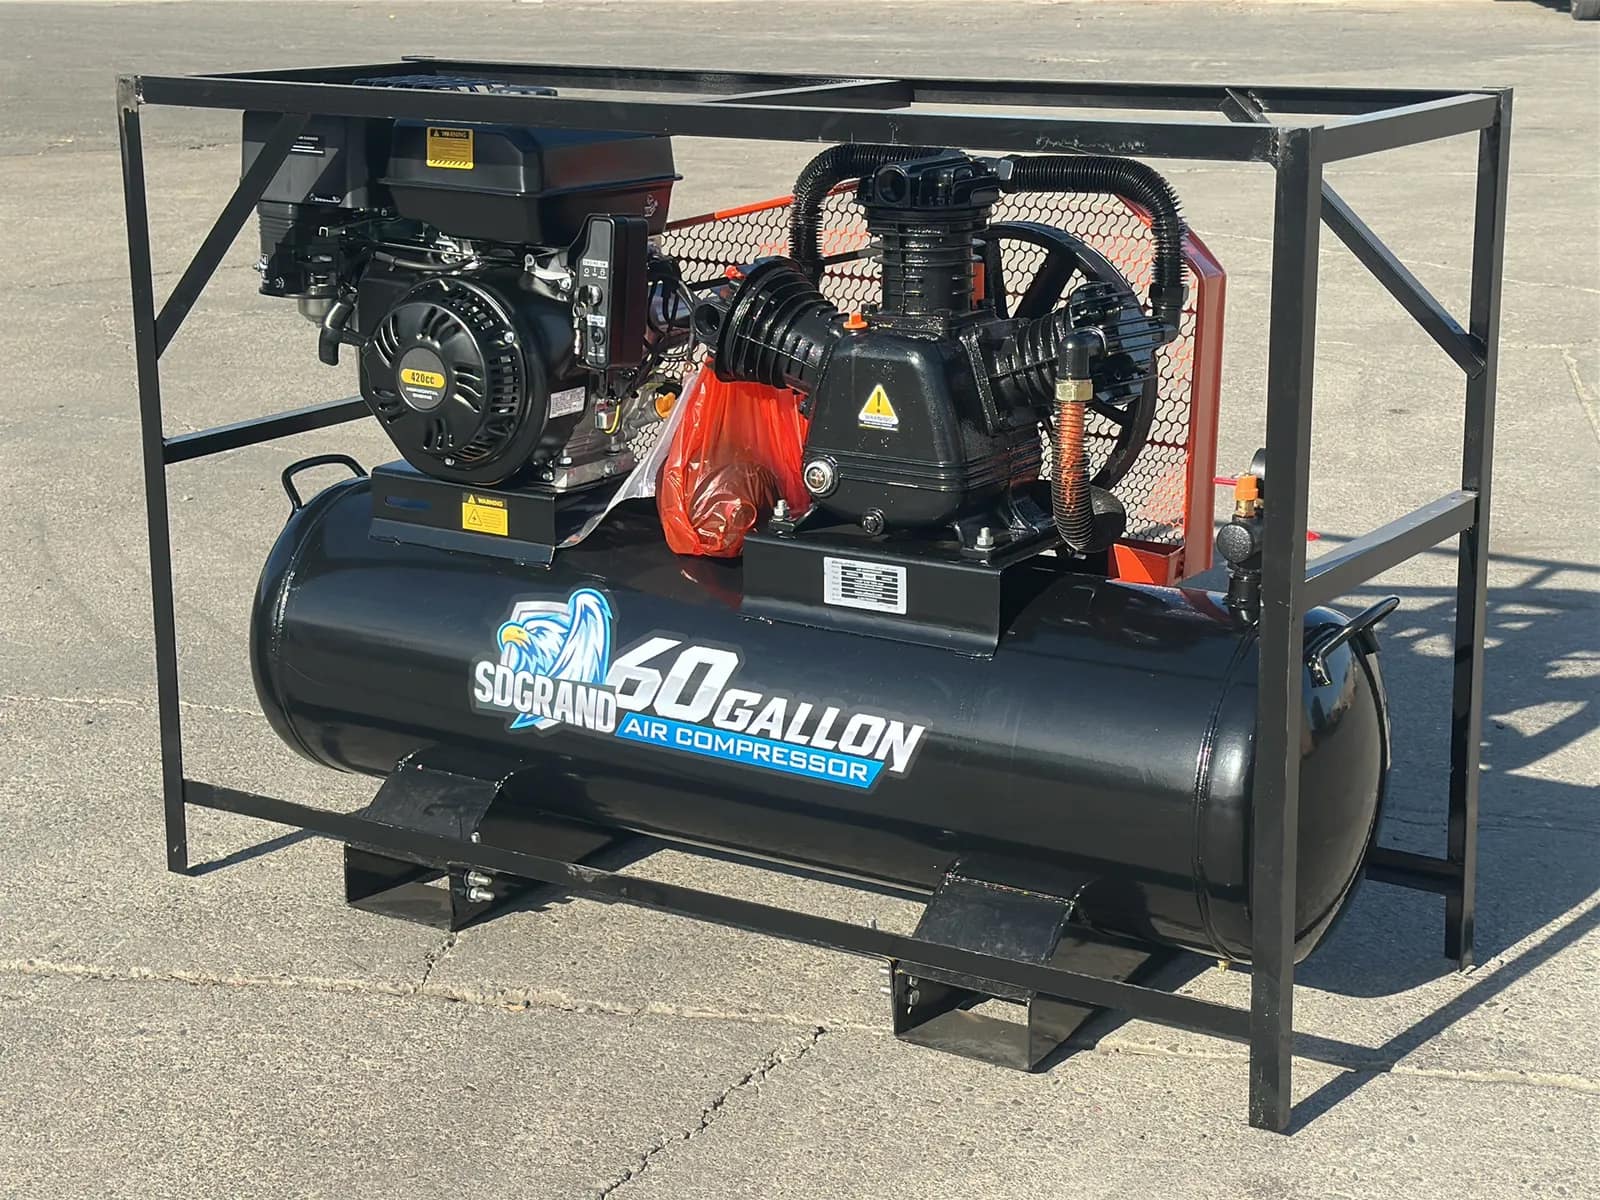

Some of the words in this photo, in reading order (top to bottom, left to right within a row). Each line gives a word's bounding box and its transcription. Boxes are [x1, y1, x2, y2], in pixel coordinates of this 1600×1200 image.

[411, 372, 435, 385] 420cc
[474, 660, 617, 733] SDGRAND
[604, 637, 739, 722] 60
[712, 688, 926, 773] GALLON
[624, 717, 668, 742] AIR
[675, 728, 868, 782] COMPRESSOR
